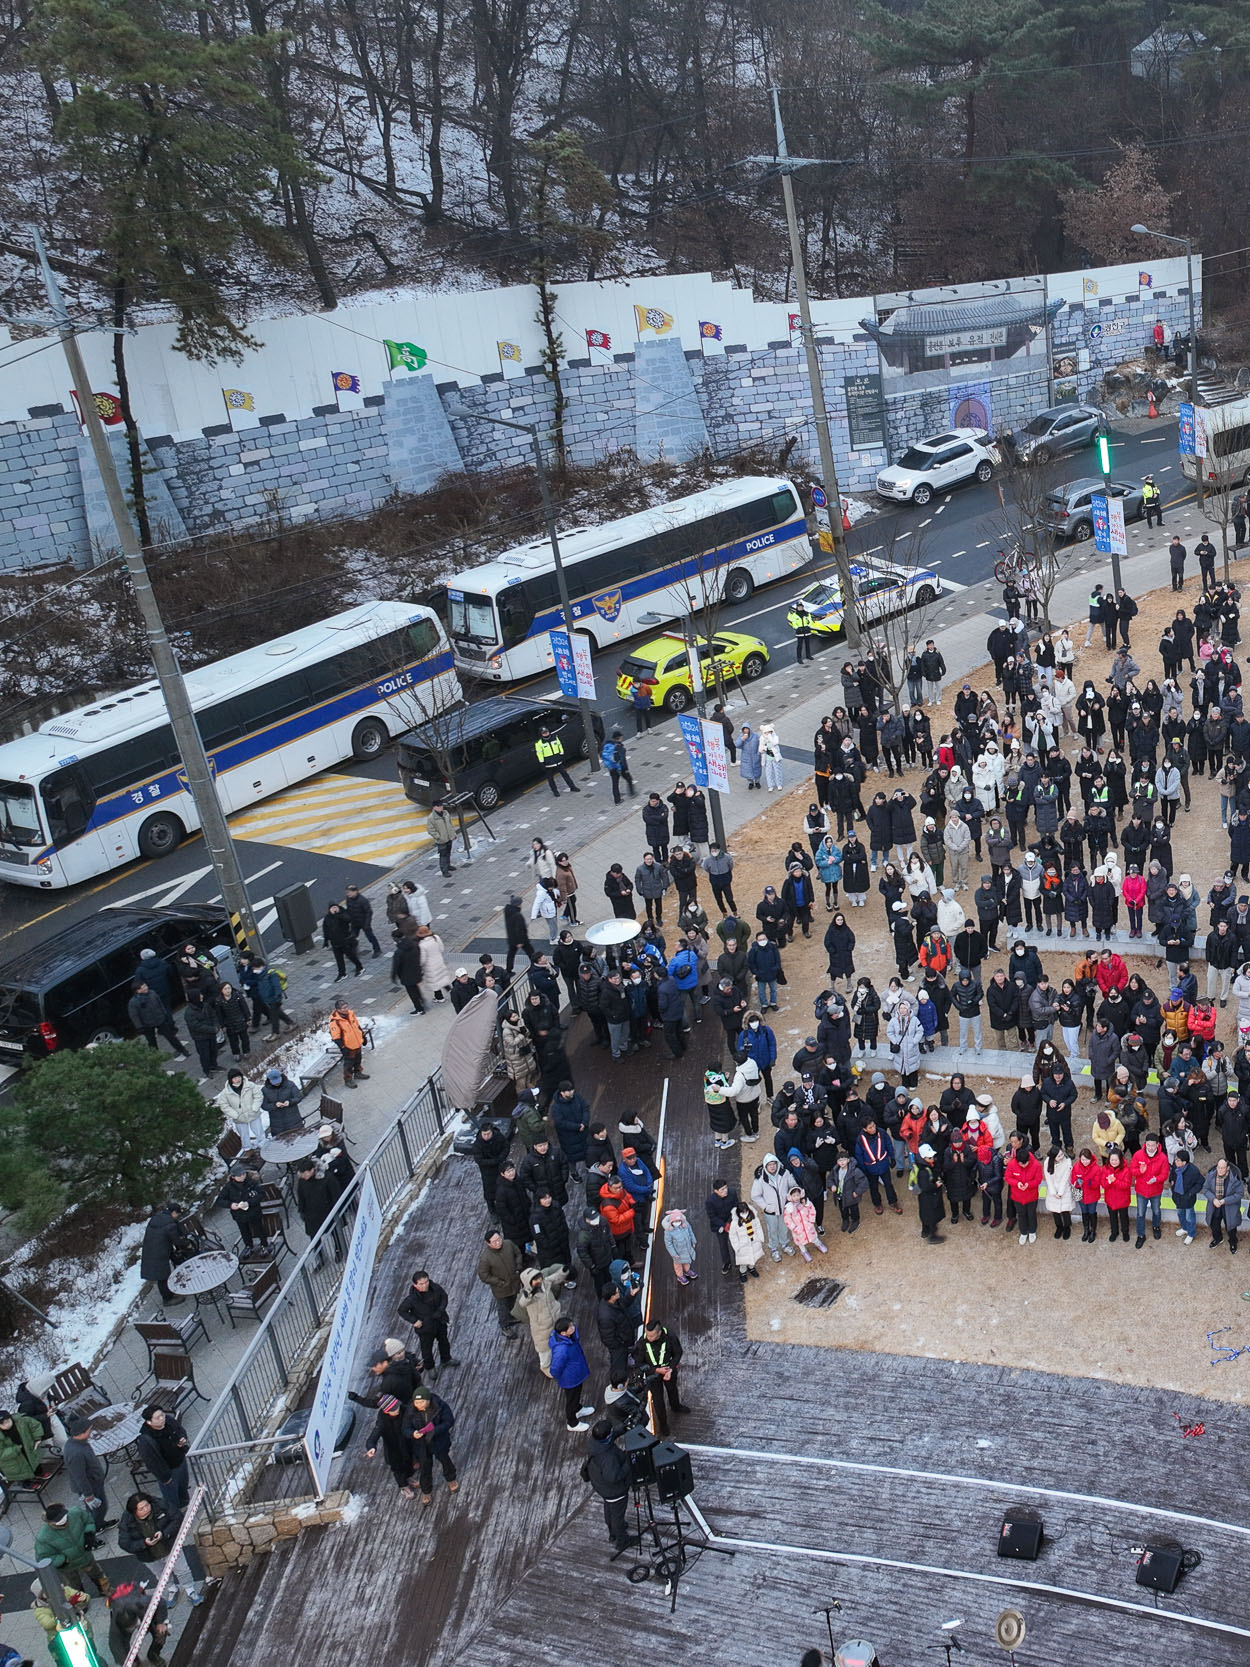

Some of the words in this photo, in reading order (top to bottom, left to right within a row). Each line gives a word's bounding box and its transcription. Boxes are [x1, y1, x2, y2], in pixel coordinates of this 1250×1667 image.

[948, 337, 961, 347] 보루
[968, 333, 983, 346] 유적
[746, 534, 775, 552] POLICE
[377, 673, 413, 697] POLICE
[708, 760, 727, 771] 새해
[320, 1373, 332, 1418] 2024
